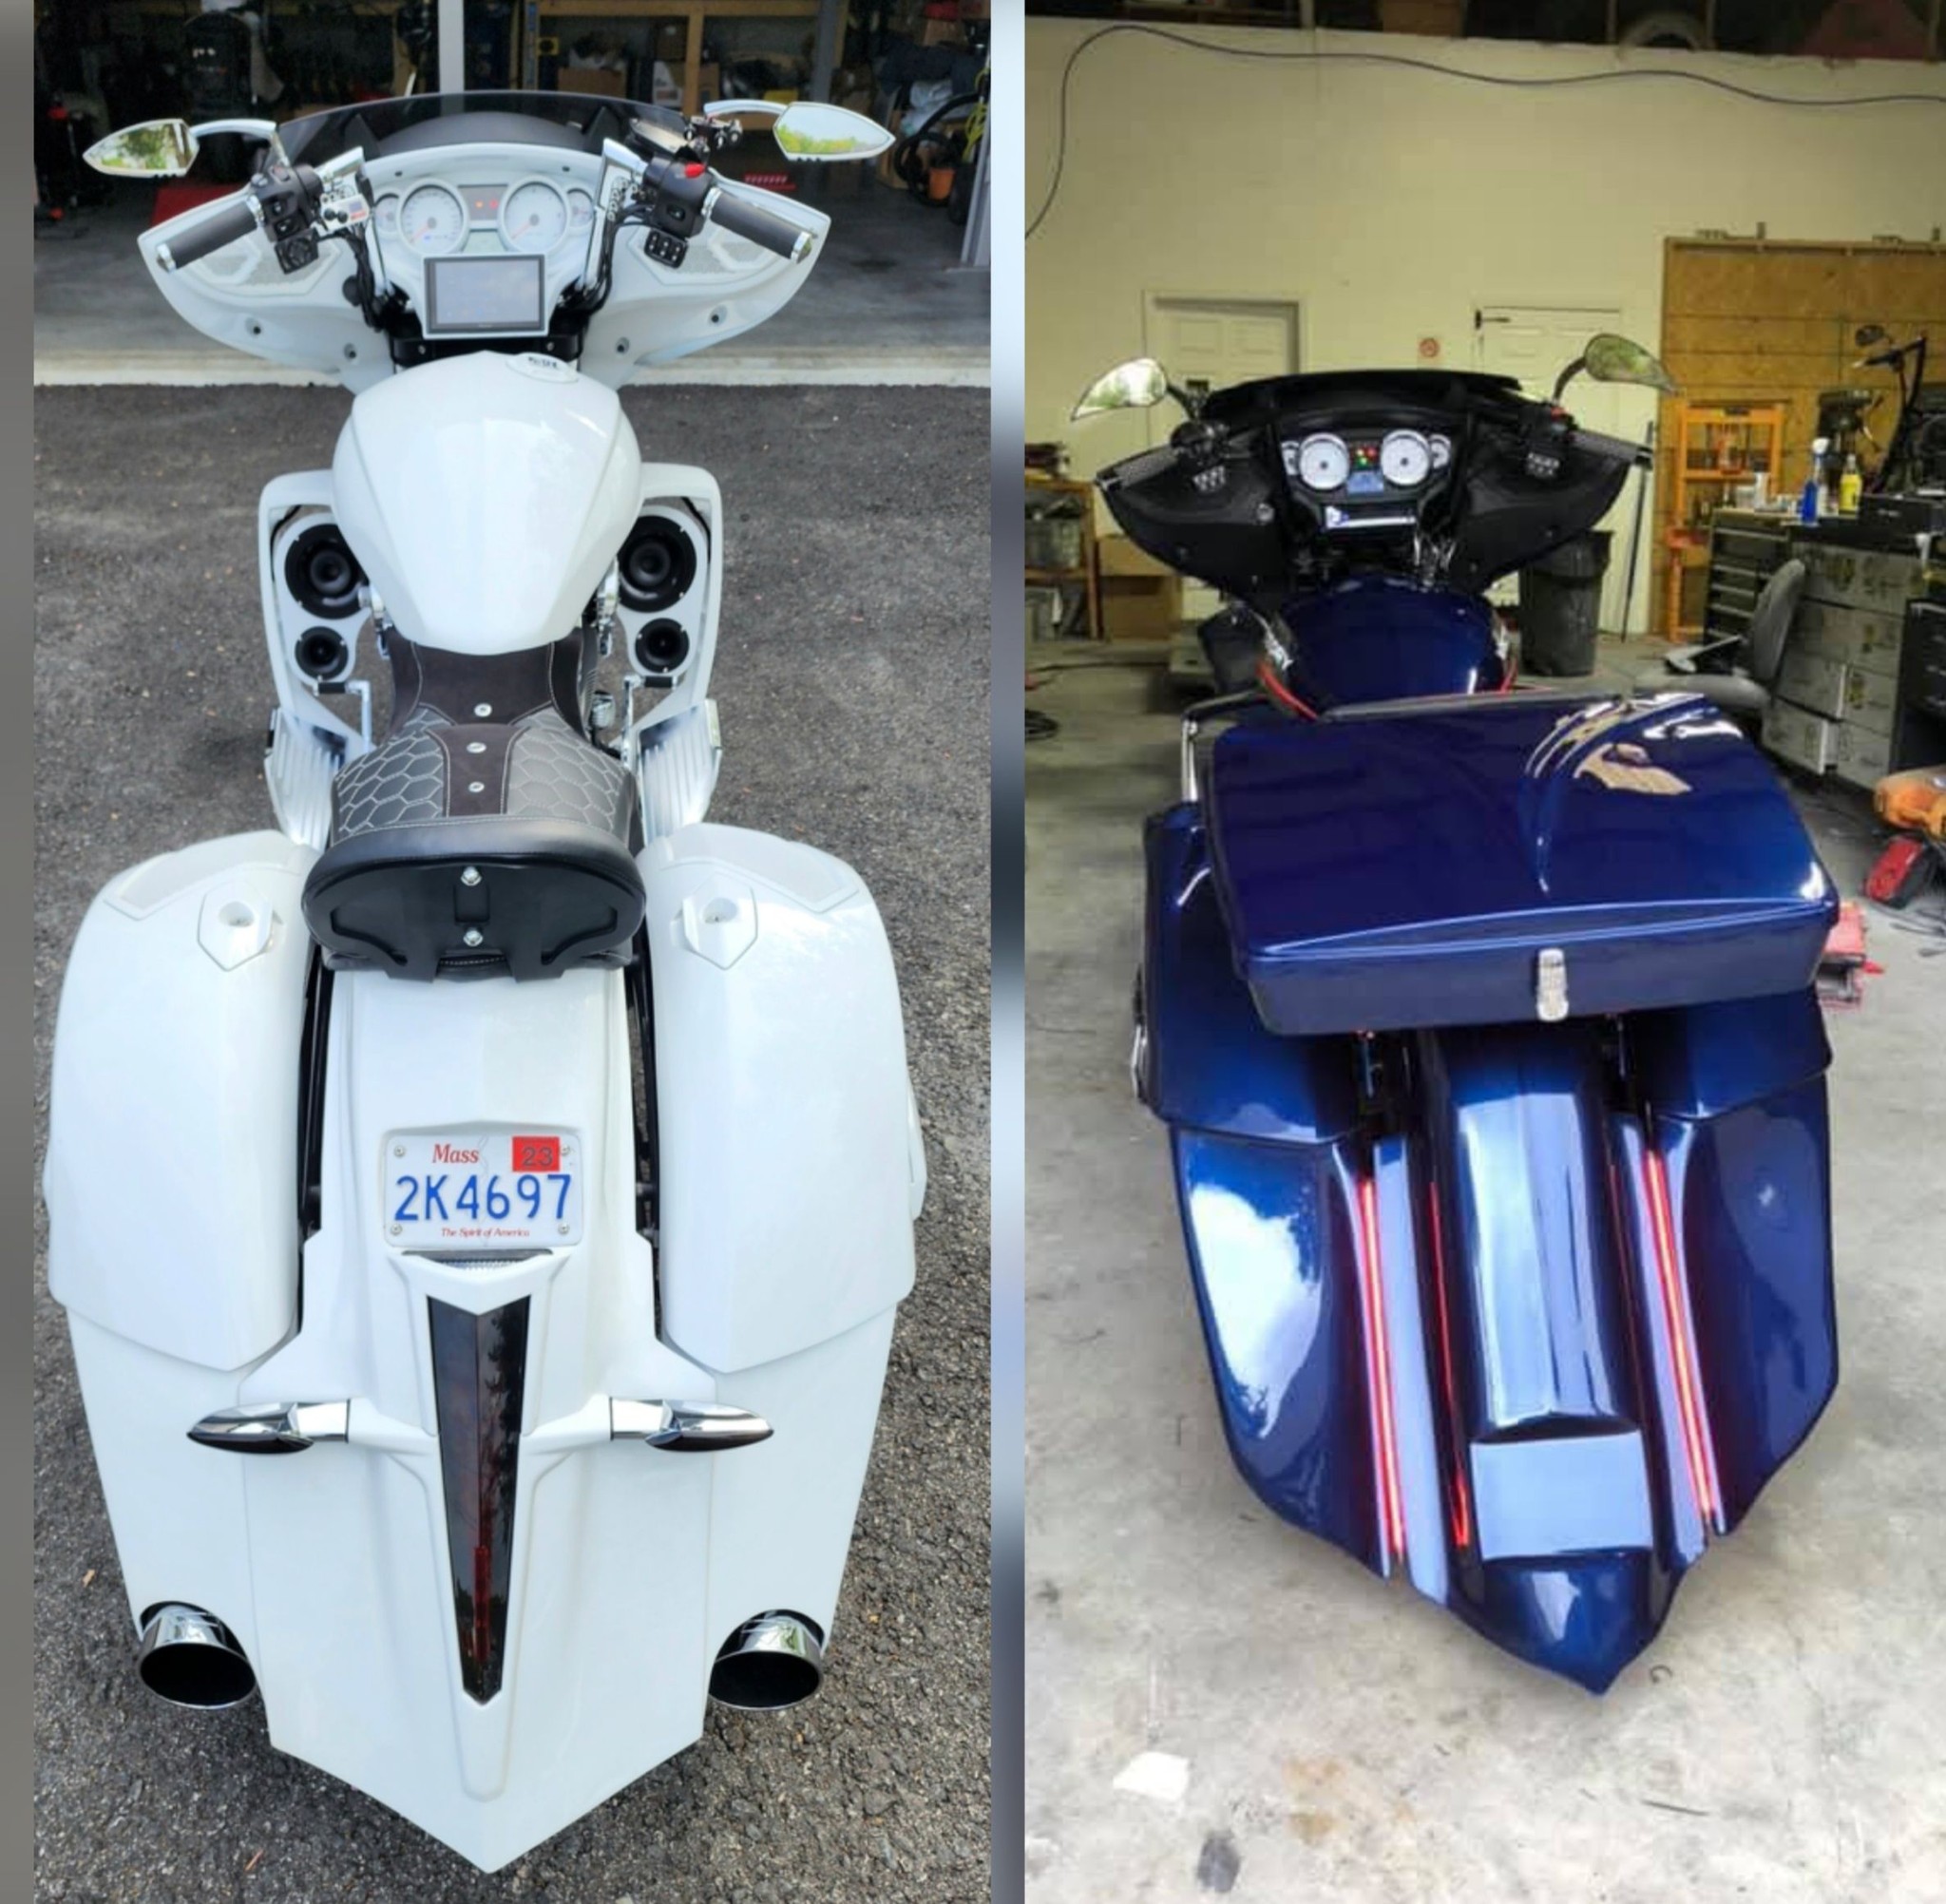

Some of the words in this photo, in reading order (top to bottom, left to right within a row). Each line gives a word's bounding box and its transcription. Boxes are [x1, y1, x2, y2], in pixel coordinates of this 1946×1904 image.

[432, 1143, 480, 1164] Mass
[523, 1146, 553, 1167] 23
[394, 1173, 572, 1221] 2K4697
[442, 1228, 456, 1237] The
[460, 1227, 482, 1238] Spirit
[494, 1228, 530, 1237] America
